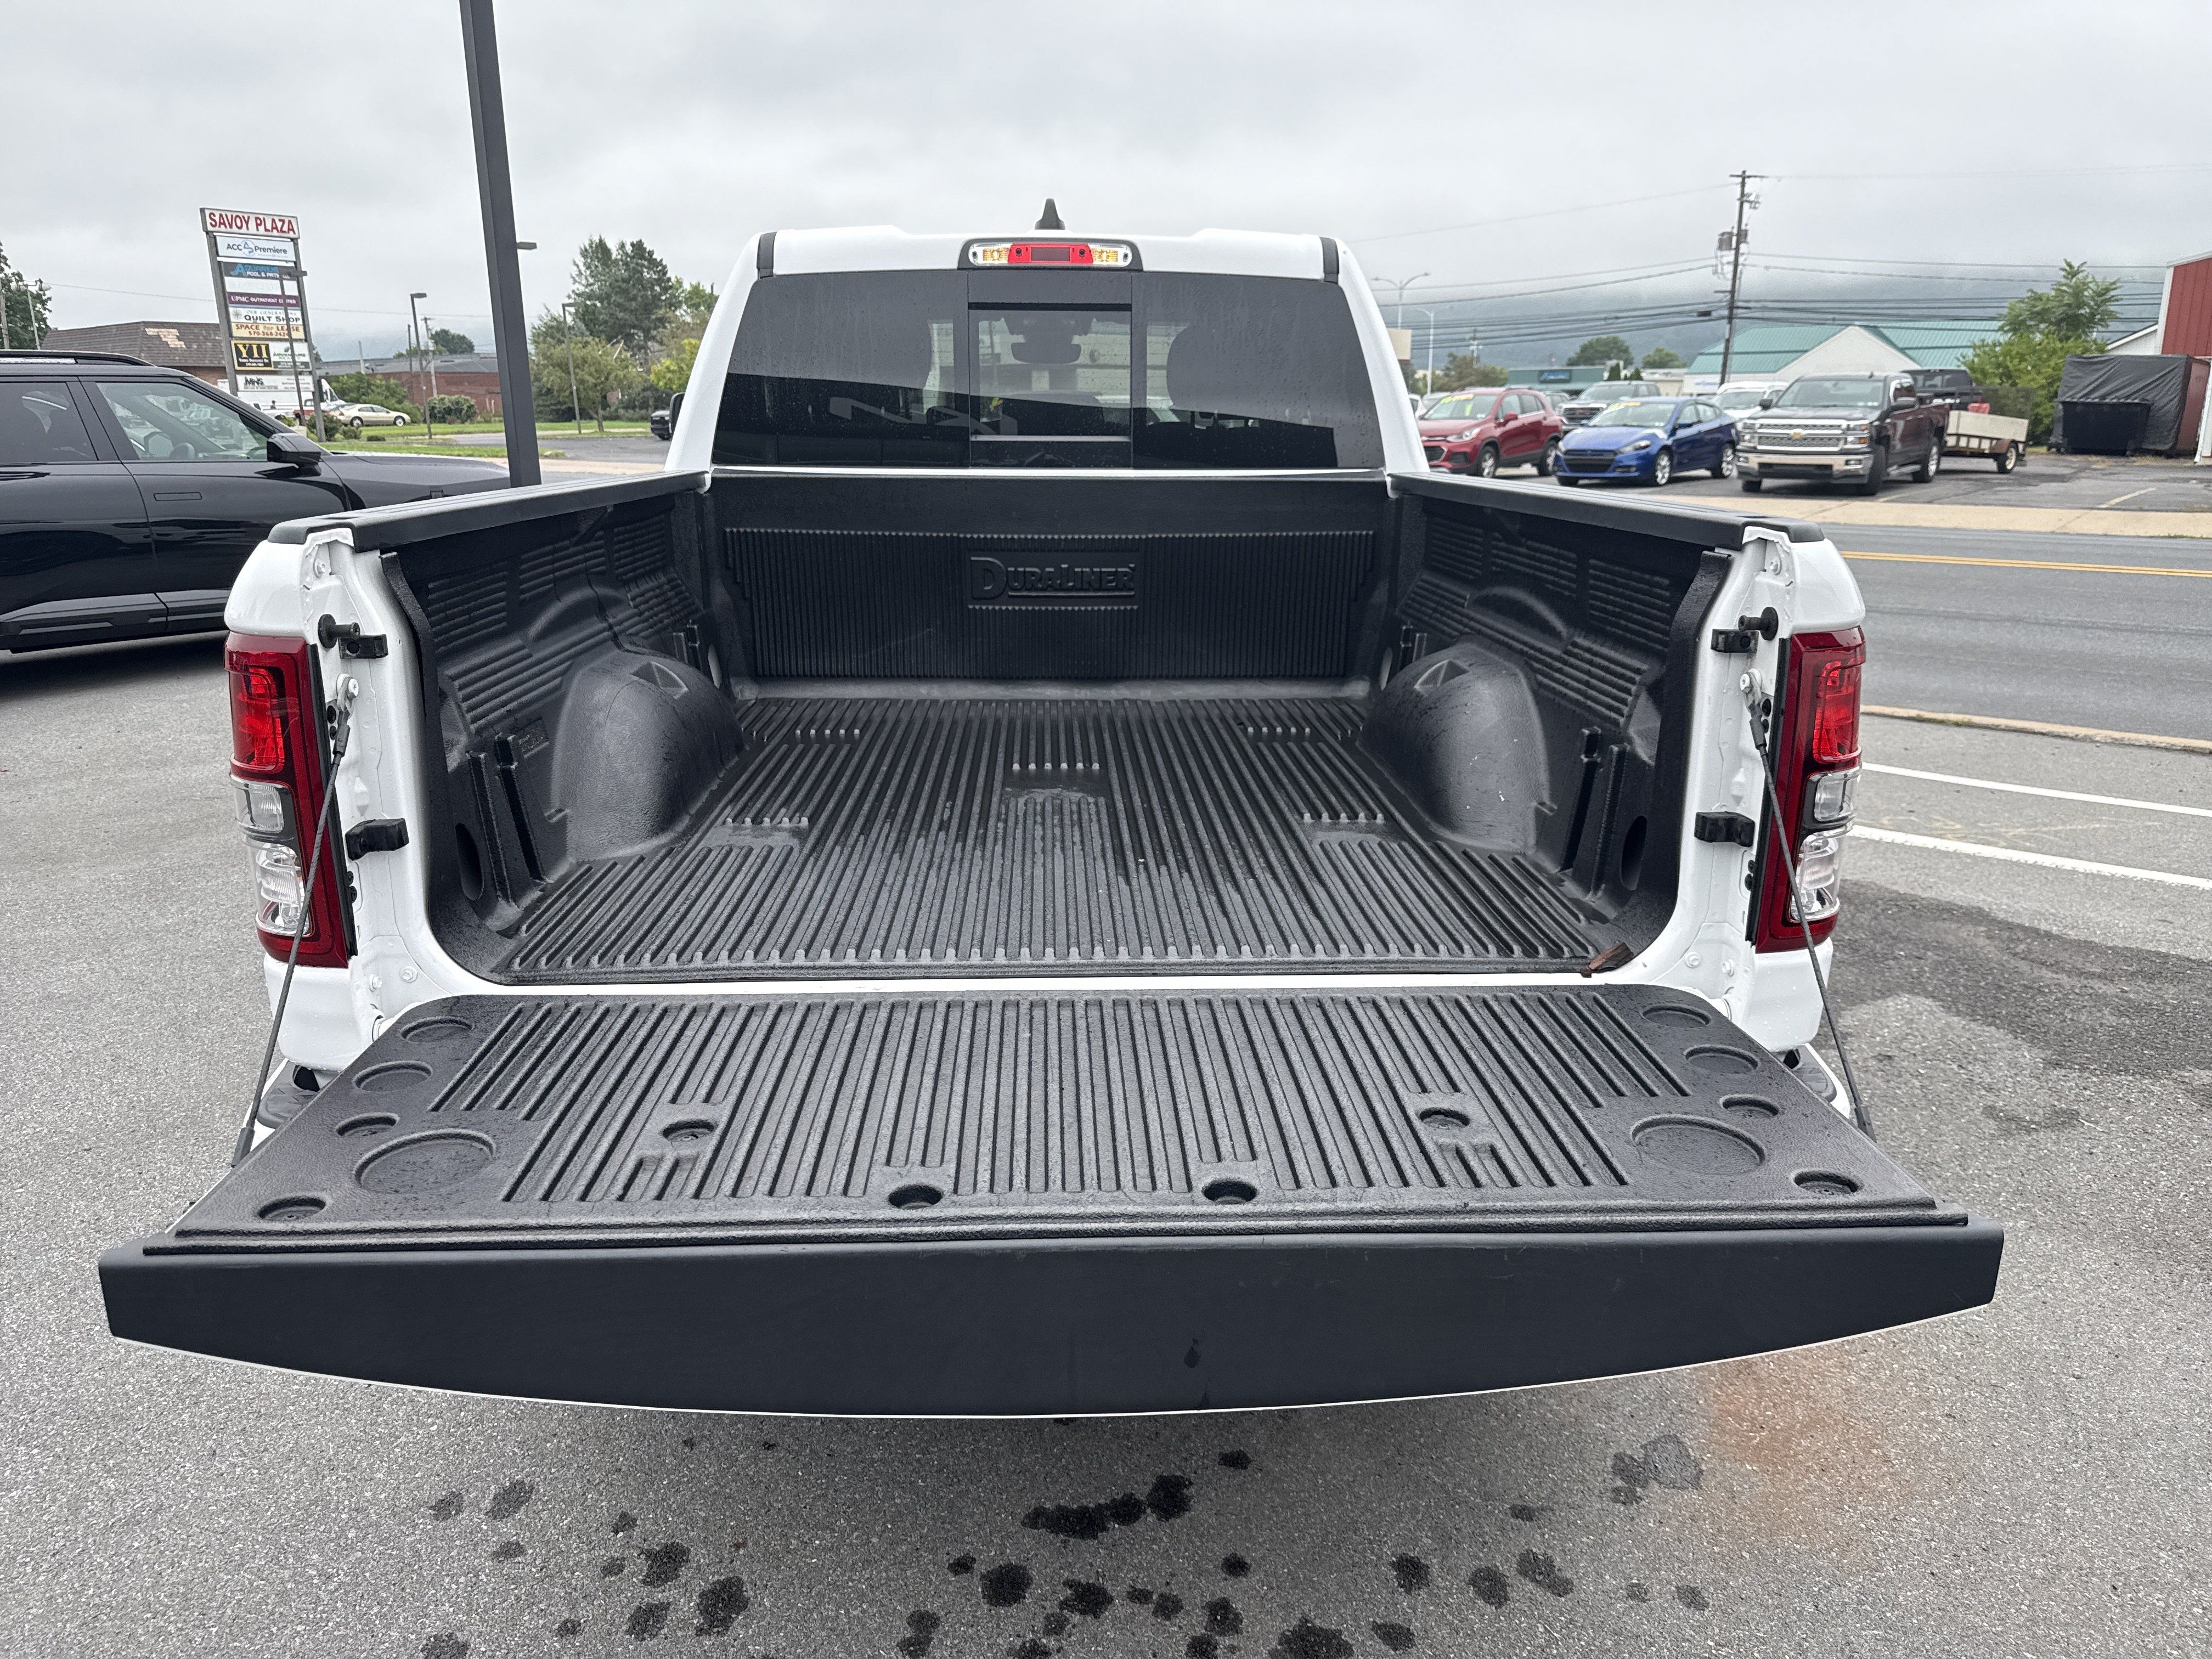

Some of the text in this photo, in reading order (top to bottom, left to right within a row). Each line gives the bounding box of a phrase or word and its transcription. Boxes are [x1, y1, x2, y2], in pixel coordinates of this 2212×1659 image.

[208, 212, 296, 234] SAVOY PLAZA
[255, 245, 287, 255] Premiere
[236, 343, 269, 358] YII
